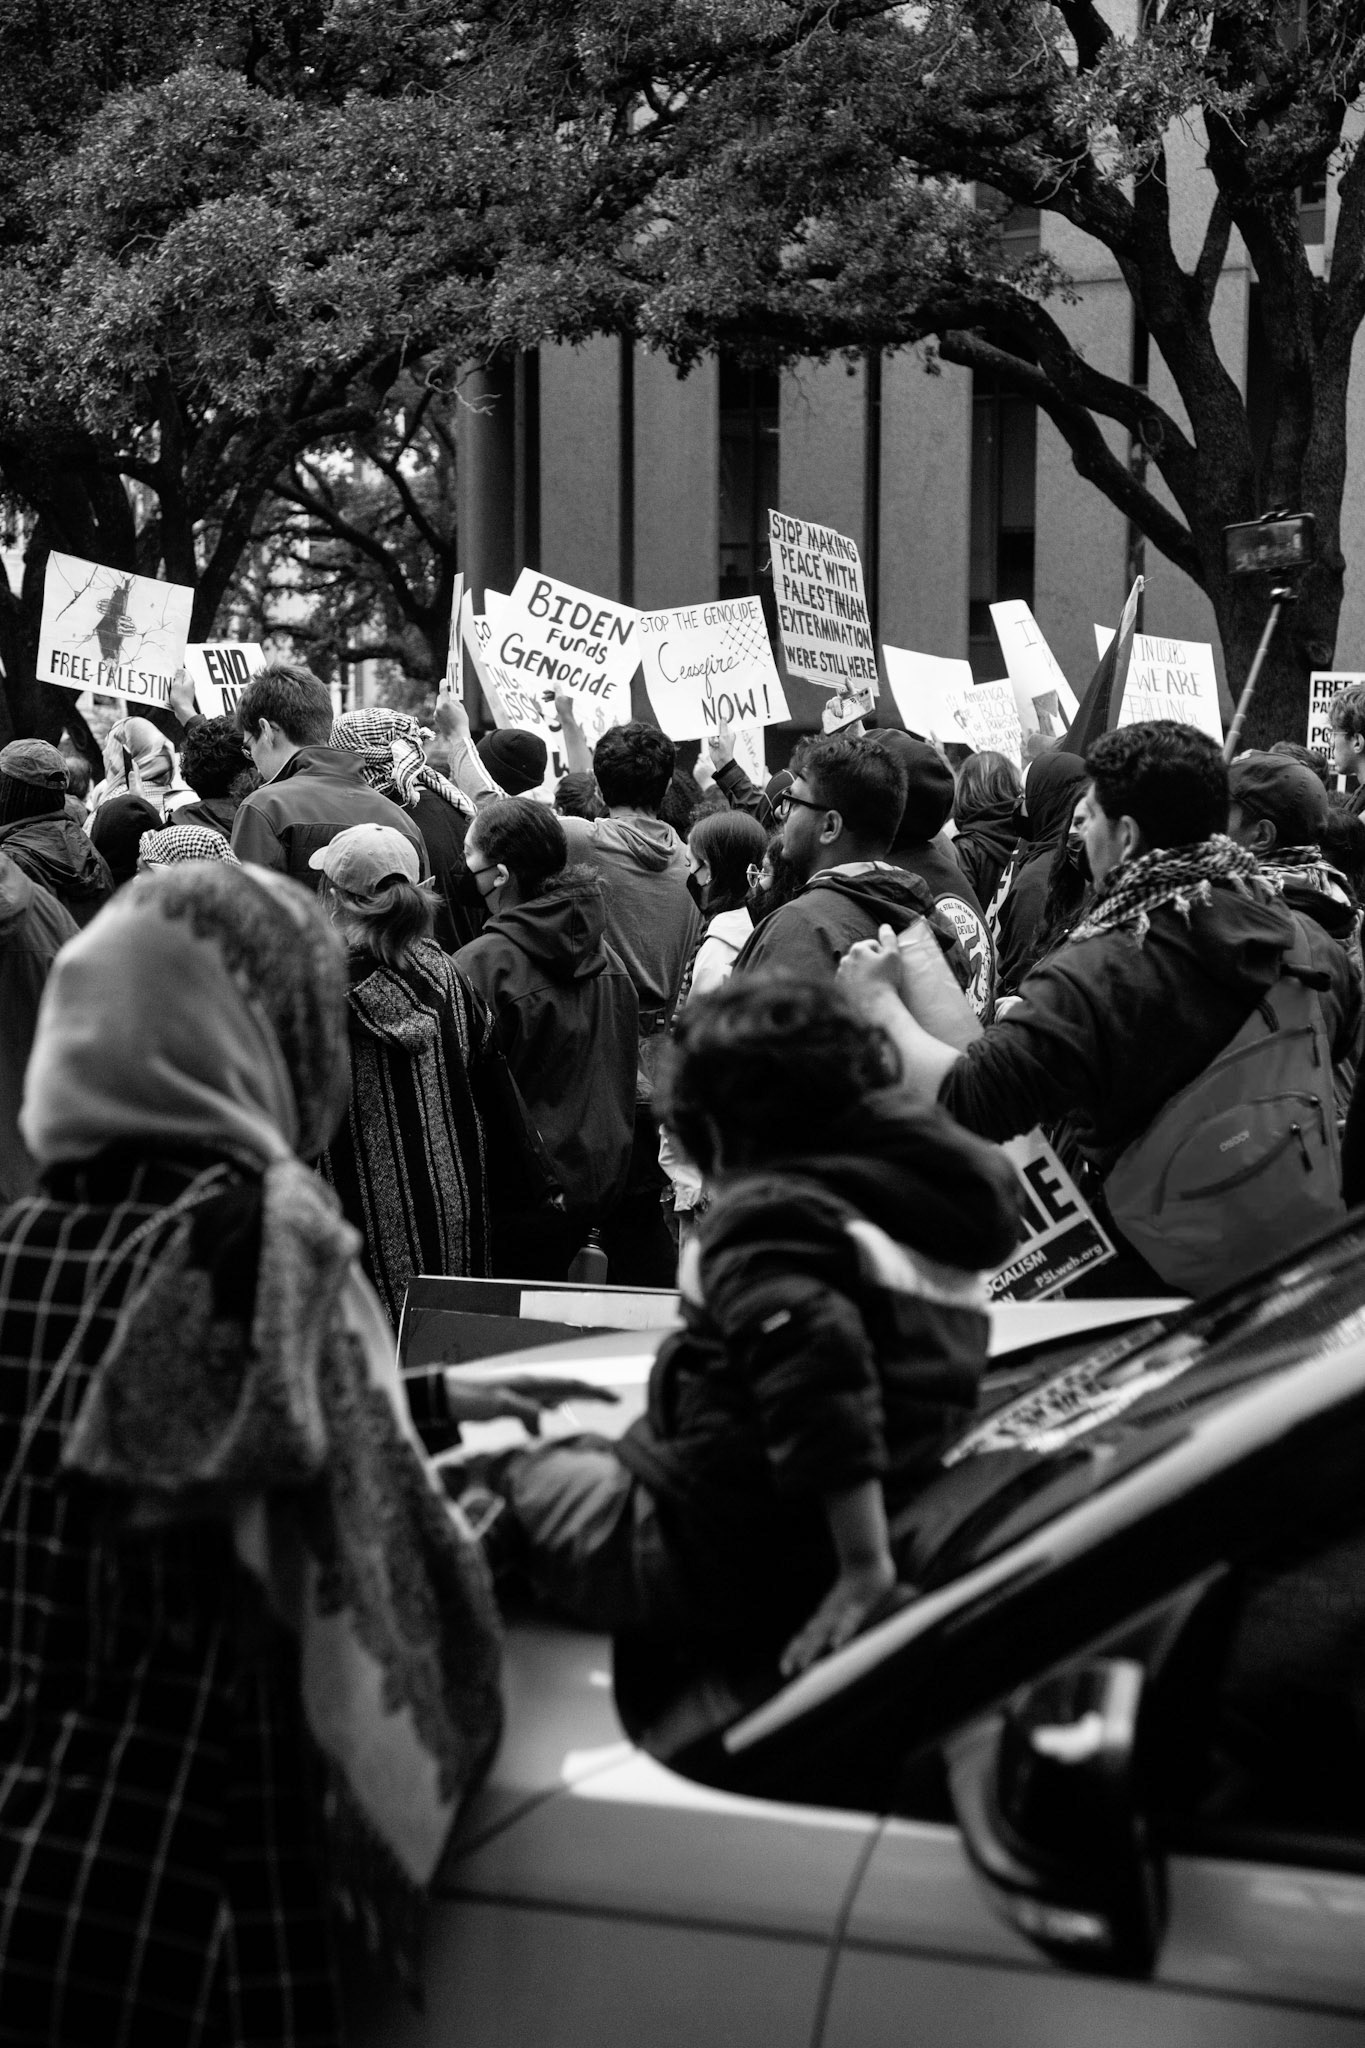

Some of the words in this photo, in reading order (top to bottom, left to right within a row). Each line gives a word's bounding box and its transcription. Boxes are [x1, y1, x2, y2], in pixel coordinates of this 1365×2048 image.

[772, 513, 802, 545] STOP
[823, 558, 858, 592] WITH
[528, 580, 634, 645] BIDEN
[783, 574, 868, 624] PALESTINIAN
[640, 615, 669, 633] STOP
[673, 610, 699, 630] THE
[703, 601, 757, 626] GENOCIDE
[50, 649, 91, 682] FREE
[97, 661, 173, 702] PALESTIN
[202, 649, 251, 685] END
[658, 641, 740, 700] Ceasefire
[785, 645, 818, 669] WERE
[820, 650, 848, 676] STILL
[848, 655, 876, 680] HERE
[1133, 666, 1161, 692] WE
[1166, 668, 1203, 698] ARE
[1313, 680, 1353, 698] FRE
[955, 915, 966, 924] OLD
[957, 925, 975, 934] DEVILS
[984, 1249, 1048, 1297] OCIALISM
[1034, 1243, 1104, 1289] PSLweb.org
